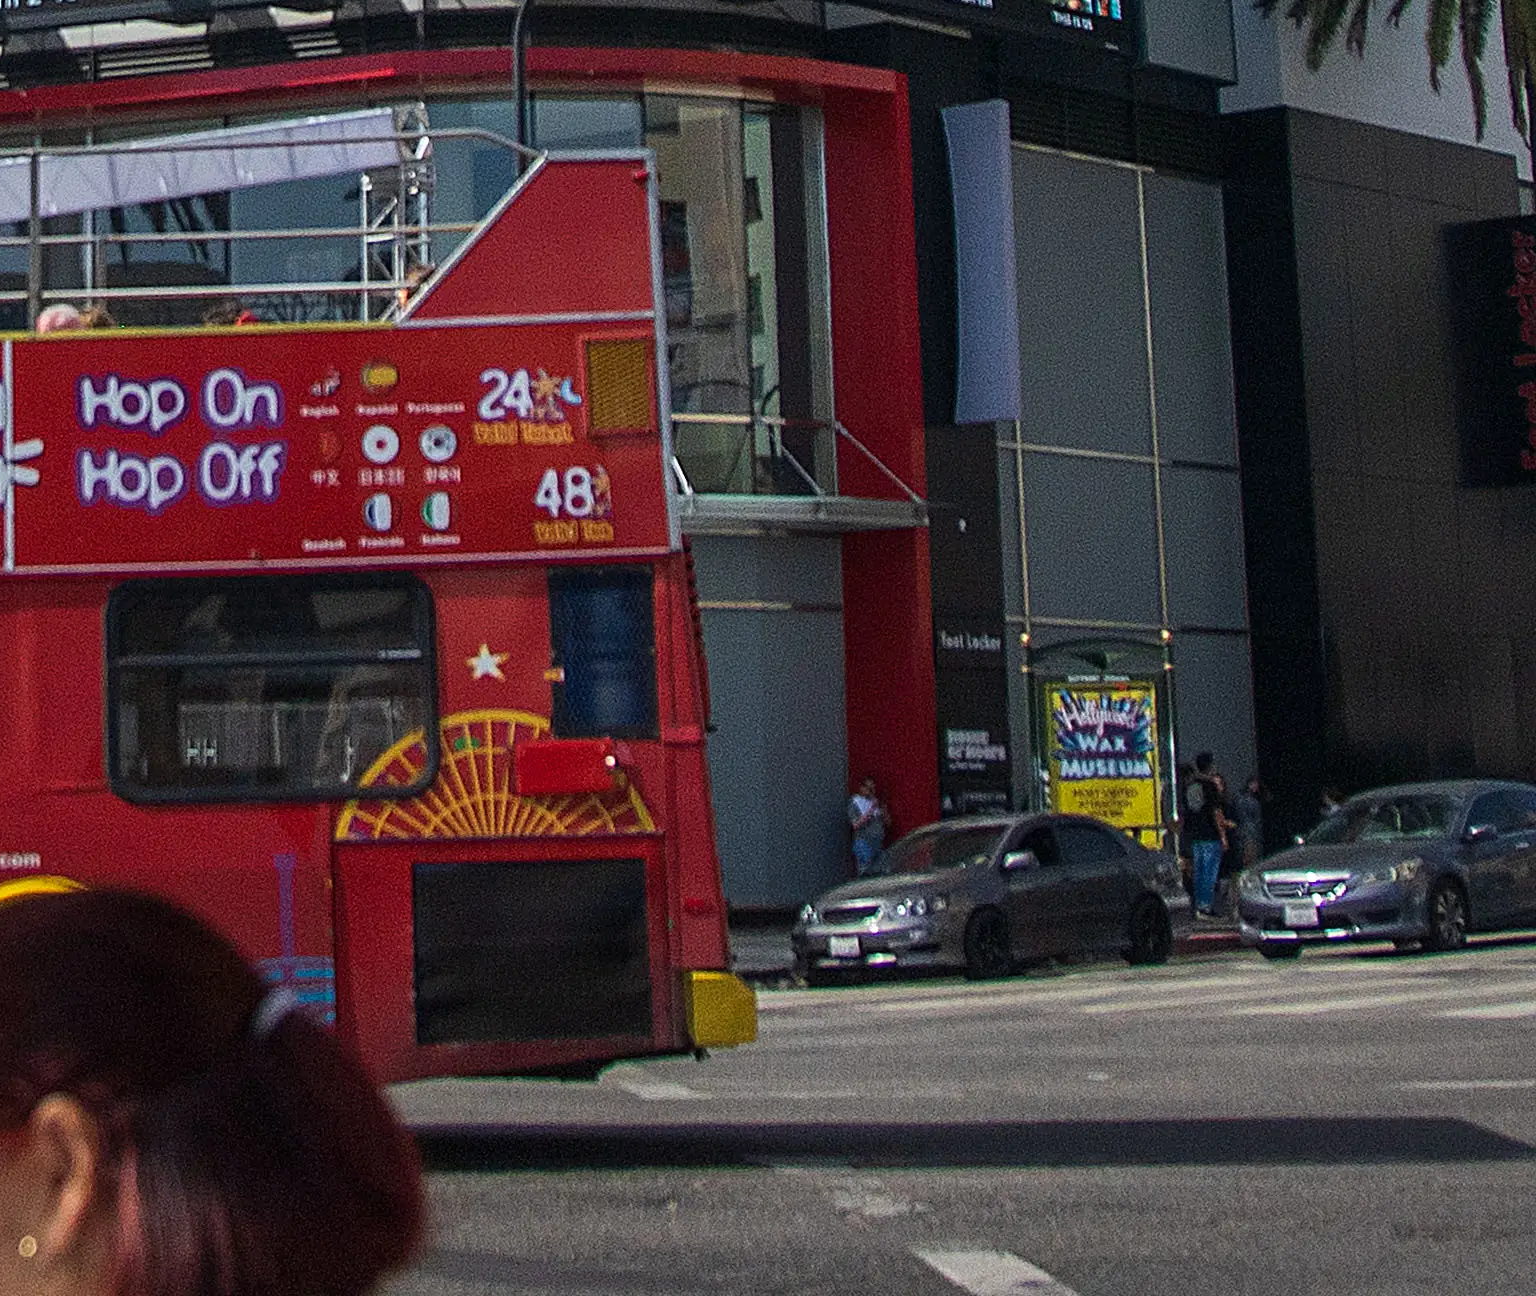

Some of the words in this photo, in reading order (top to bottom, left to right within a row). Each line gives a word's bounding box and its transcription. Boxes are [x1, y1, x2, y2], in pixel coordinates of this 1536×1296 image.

[79, 376, 186, 433] Hop
[201, 366, 284, 428] On
[479, 367, 534, 421] 24
[78, 452, 186, 511] Hop
[200, 441, 285, 504] Off
[535, 465, 595, 519] 48
[967, 633, 1002, 651] Locker
[1060, 759, 1152, 778] MUSEUM
[1076, 734, 1127, 752] WAX
